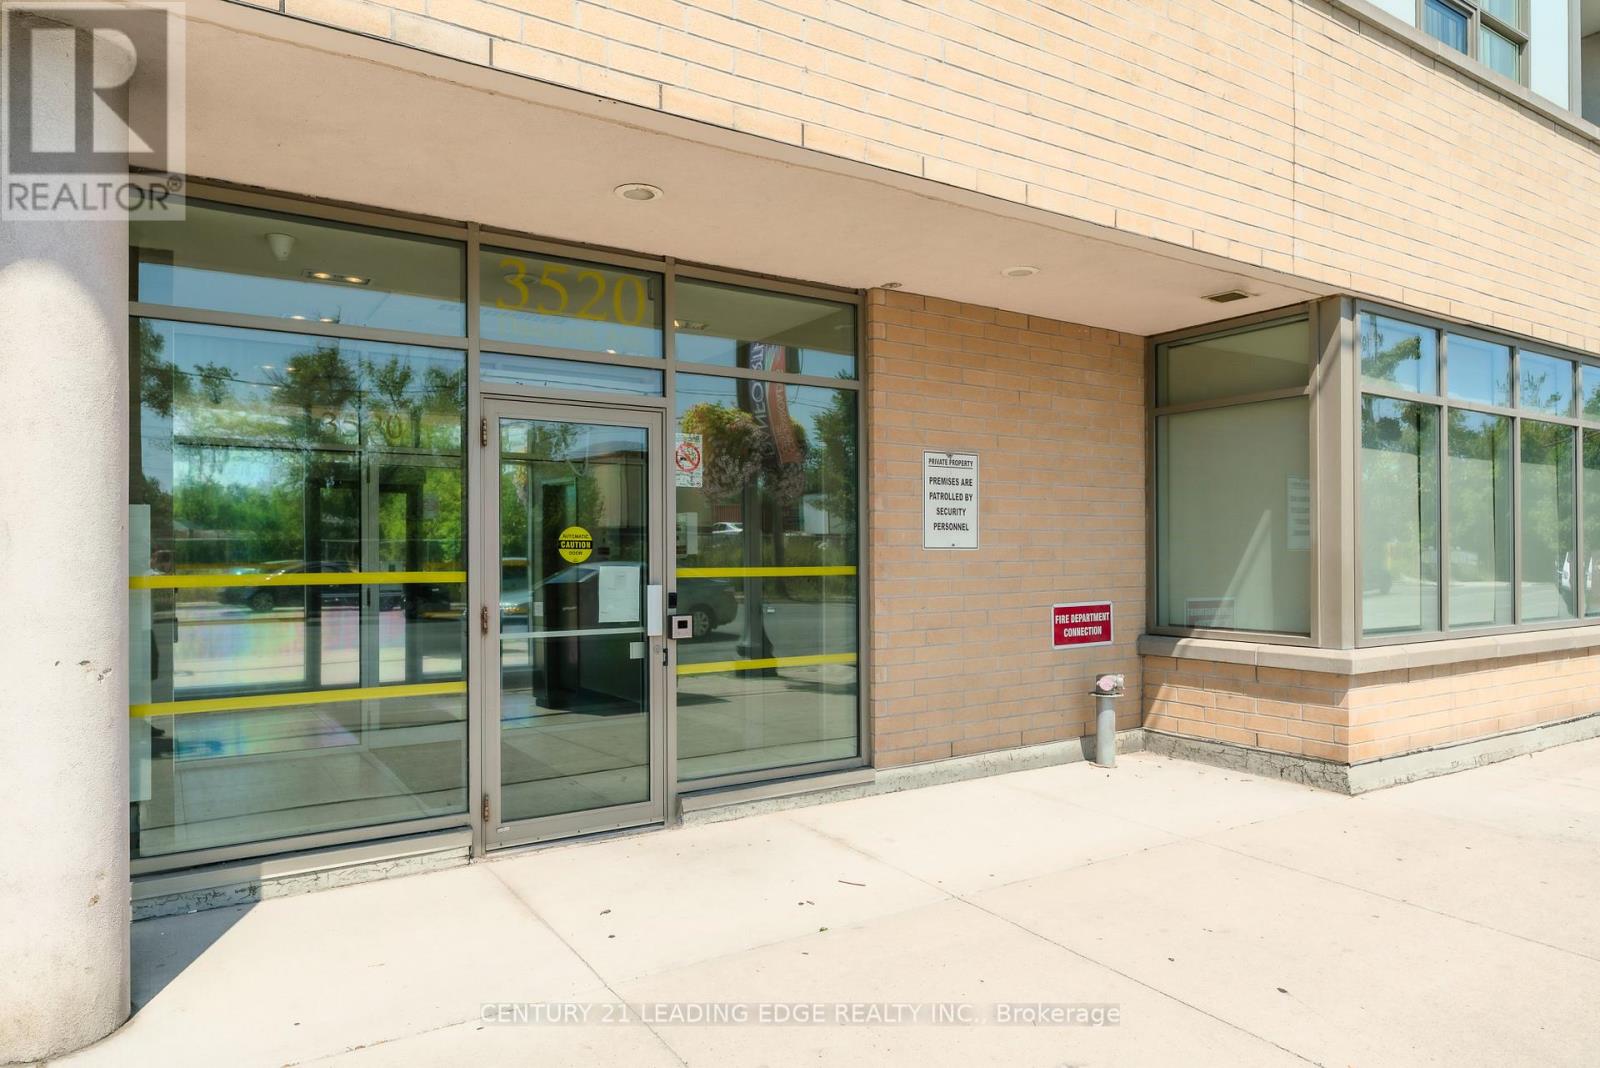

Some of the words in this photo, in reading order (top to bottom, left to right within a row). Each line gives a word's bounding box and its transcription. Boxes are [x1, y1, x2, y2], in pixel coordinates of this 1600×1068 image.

[496, 257, 646, 326] 3520
[928, 458, 948, 466] PRIVATE
[949, 459, 974, 467] PROPERTY
[929, 477, 960, 486] PREMISES
[961, 479, 973, 487] ARE
[929, 492, 963, 501] PATROLLED
[965, 493, 973, 502] BY
[936, 507, 967, 516] SECURITY
[933, 522, 969, 531] PERSONNEL
[1055, 614, 1069, 624] FIRE
[1070, 612, 1109, 623] DEPARTMENT
[1064, 626, 1102, 637] CONNECTION
